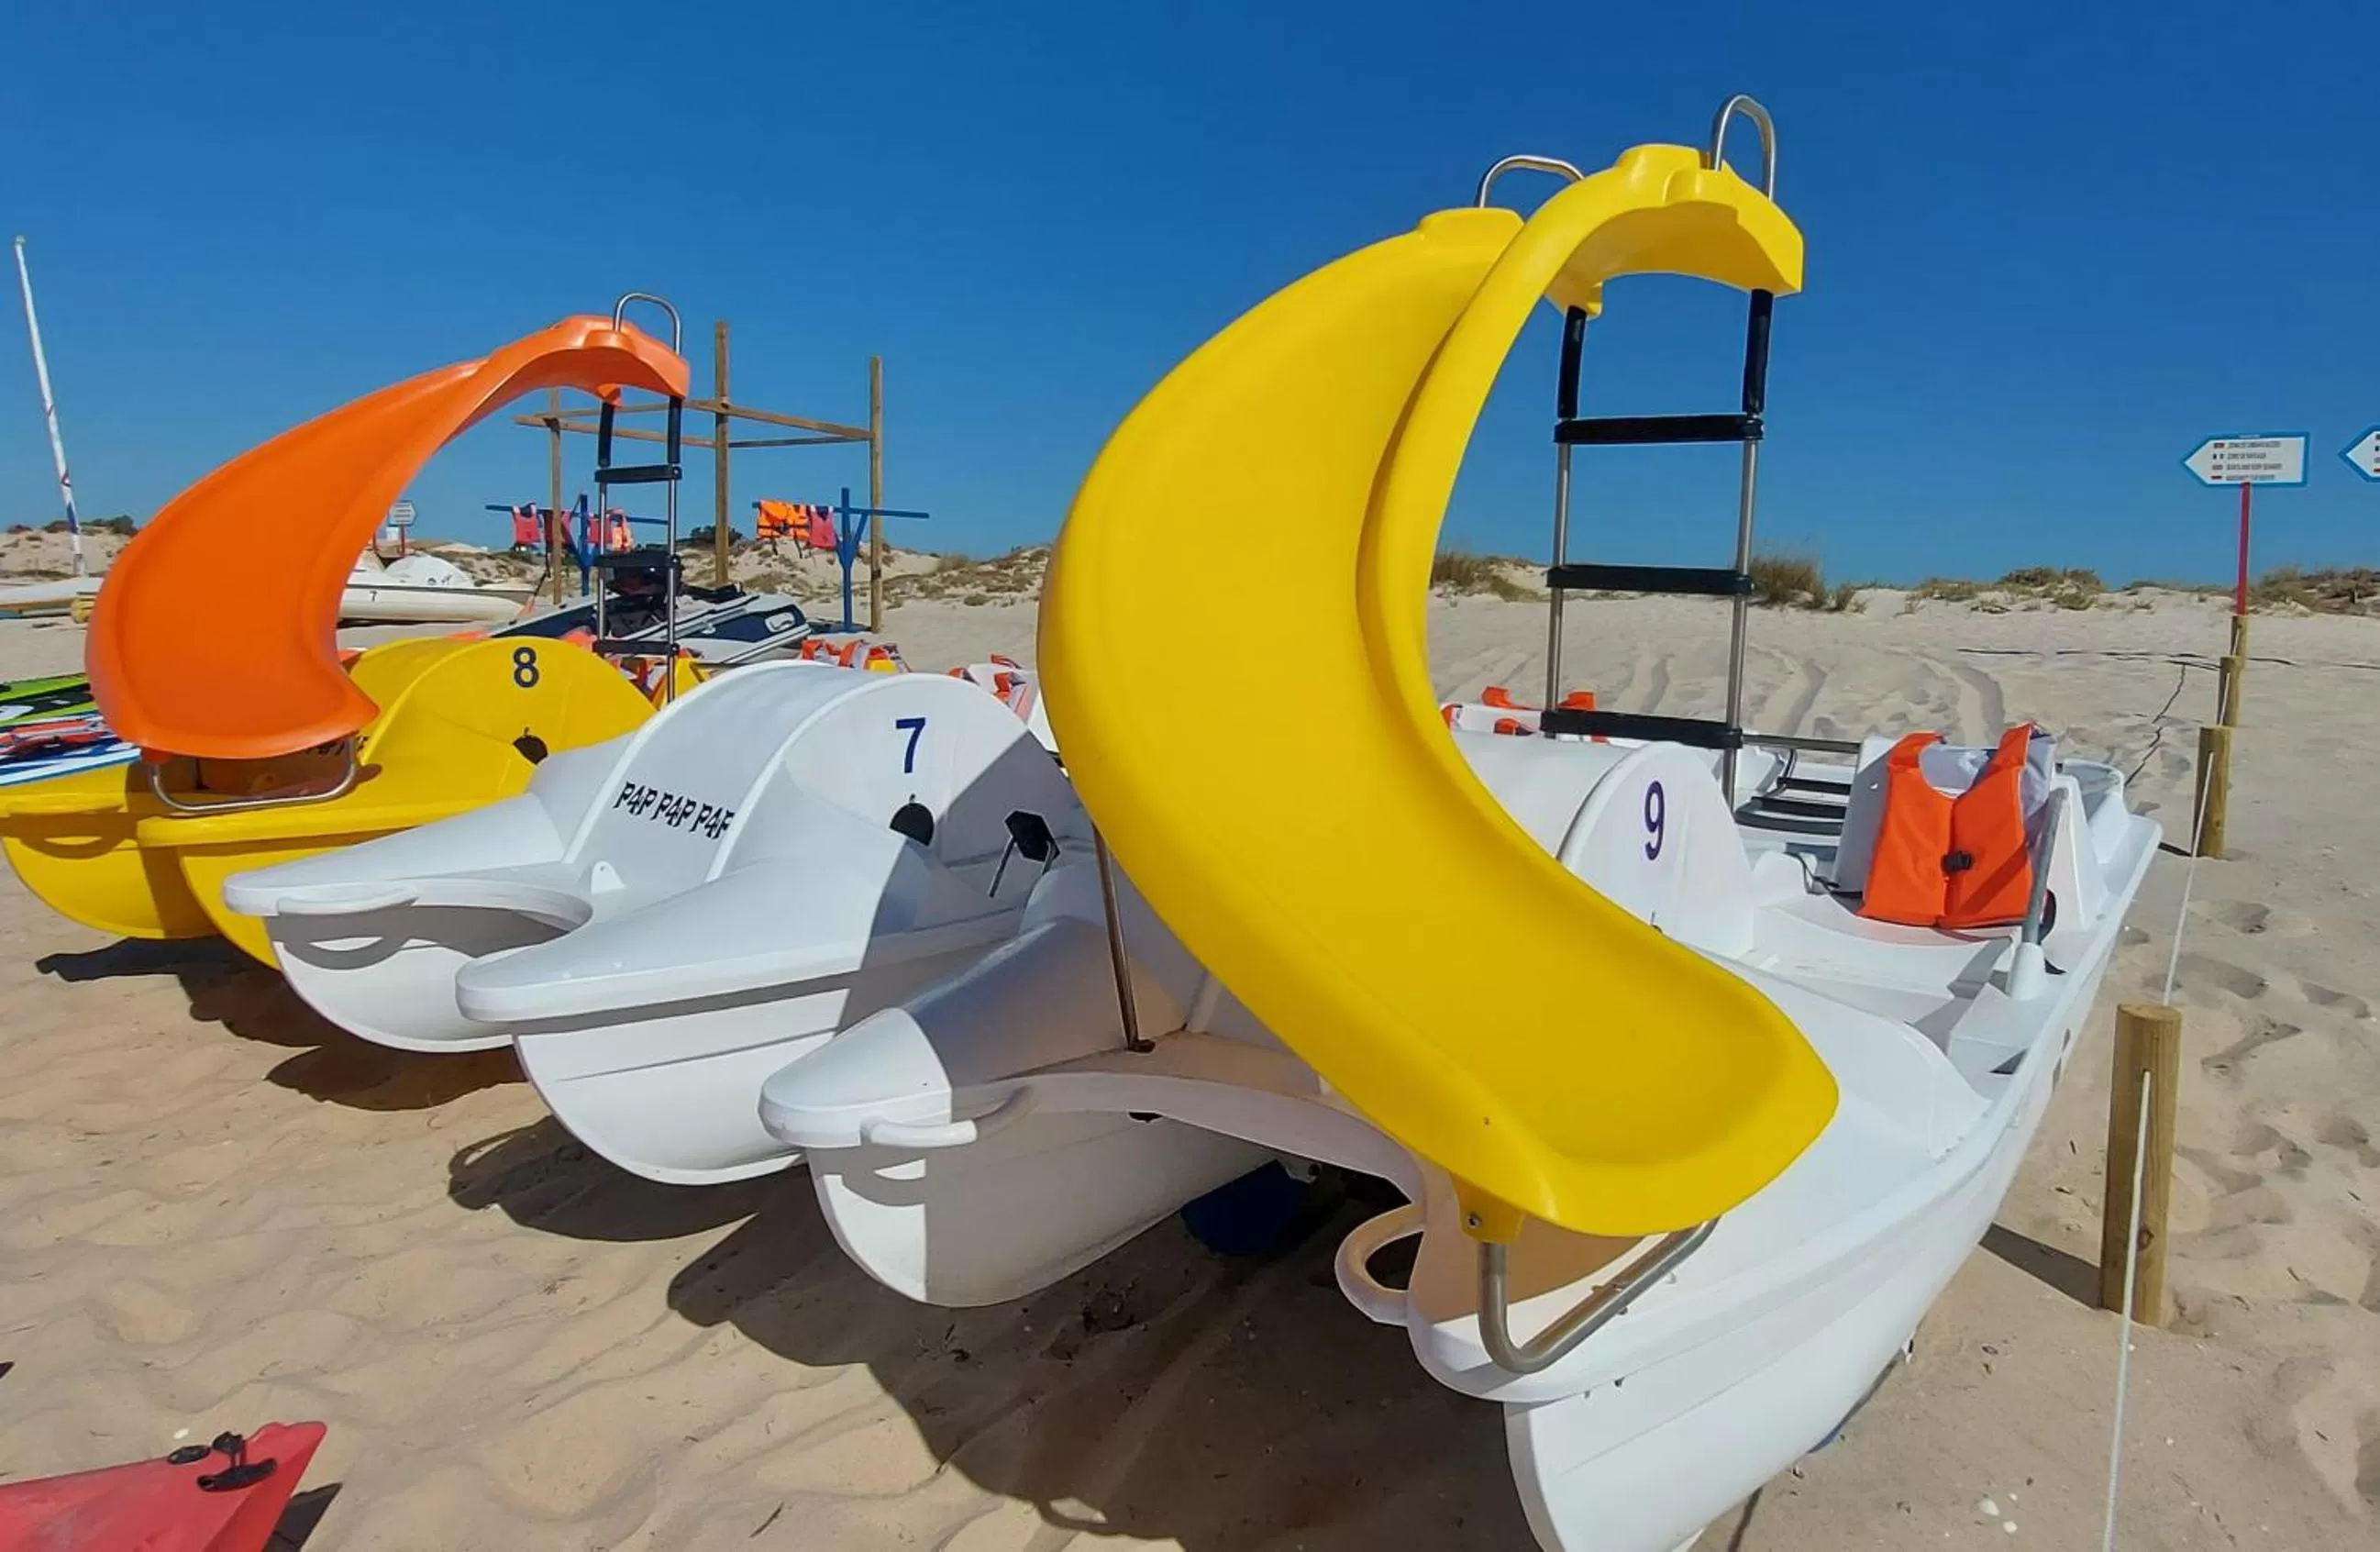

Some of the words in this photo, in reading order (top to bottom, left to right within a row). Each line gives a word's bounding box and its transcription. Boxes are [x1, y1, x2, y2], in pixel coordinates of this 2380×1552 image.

[513, 646, 540, 689] 8
[895, 716, 926, 774] 7
[1644, 780, 1666, 861] 9
